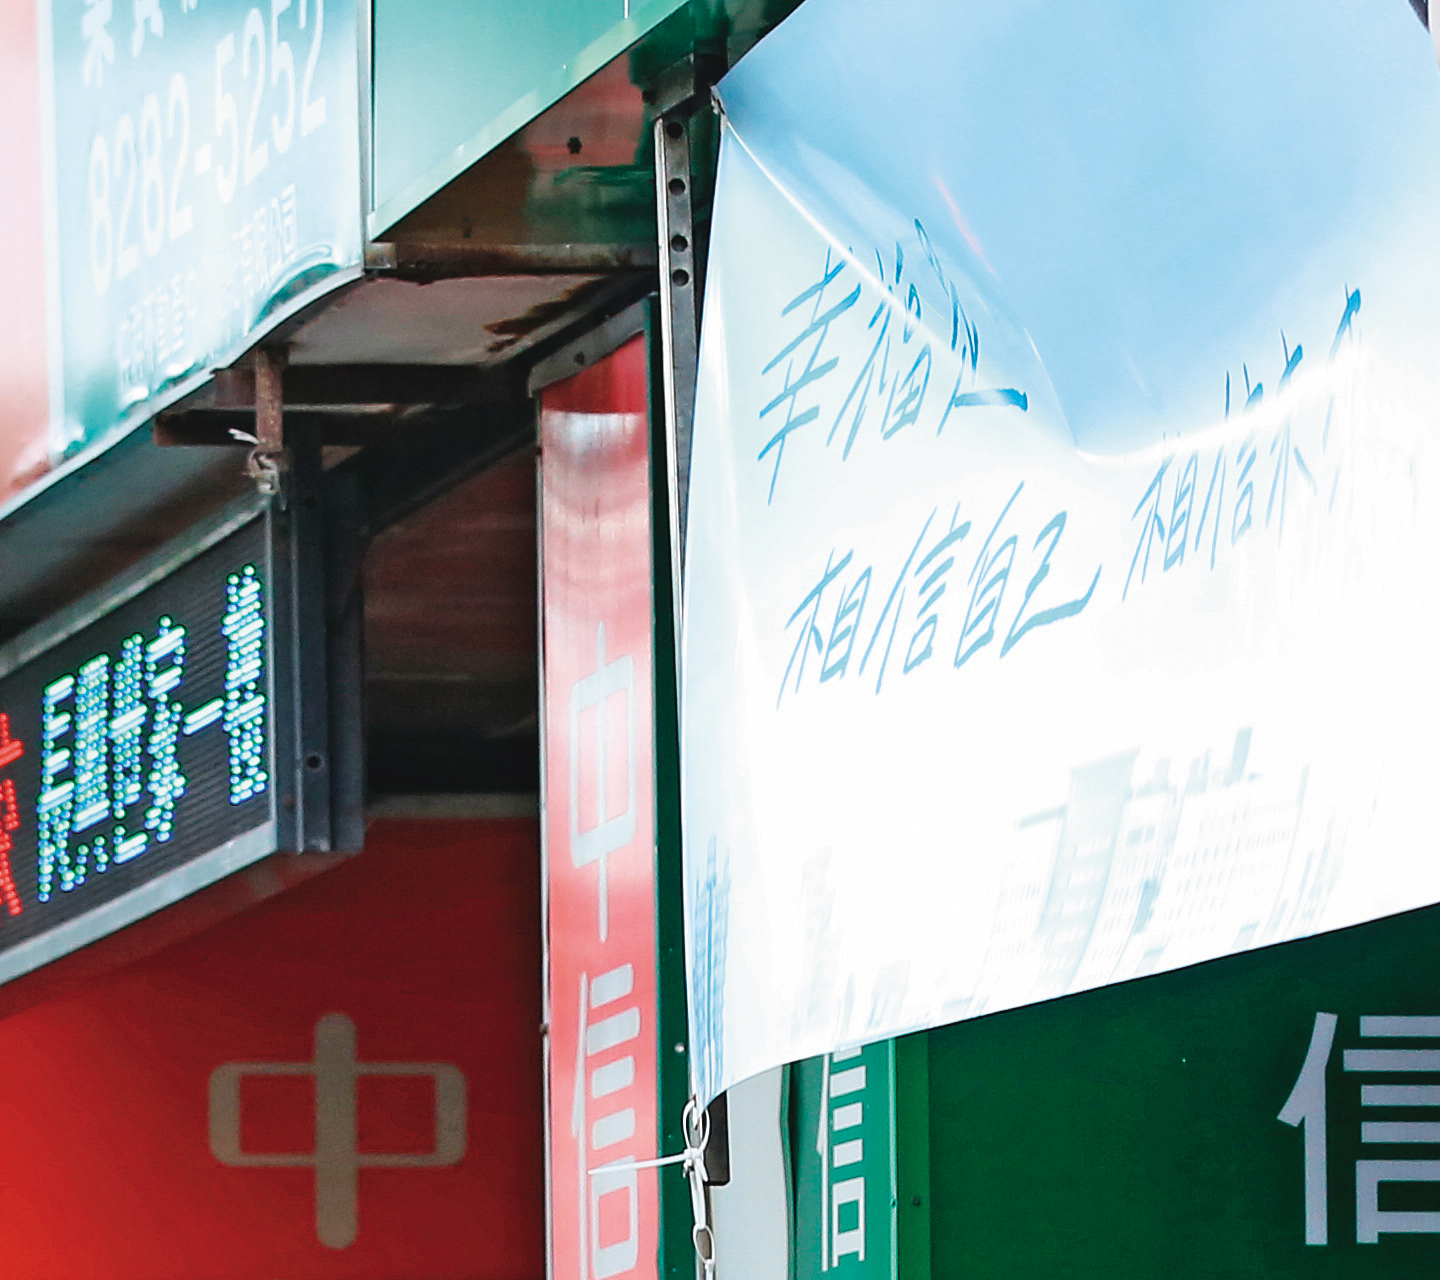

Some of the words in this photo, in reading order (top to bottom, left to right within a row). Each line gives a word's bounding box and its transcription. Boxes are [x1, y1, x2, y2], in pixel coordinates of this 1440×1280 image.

[89, 0, 328, 298] 8282-5252
[775, 480, 1103, 712] 相信自己
